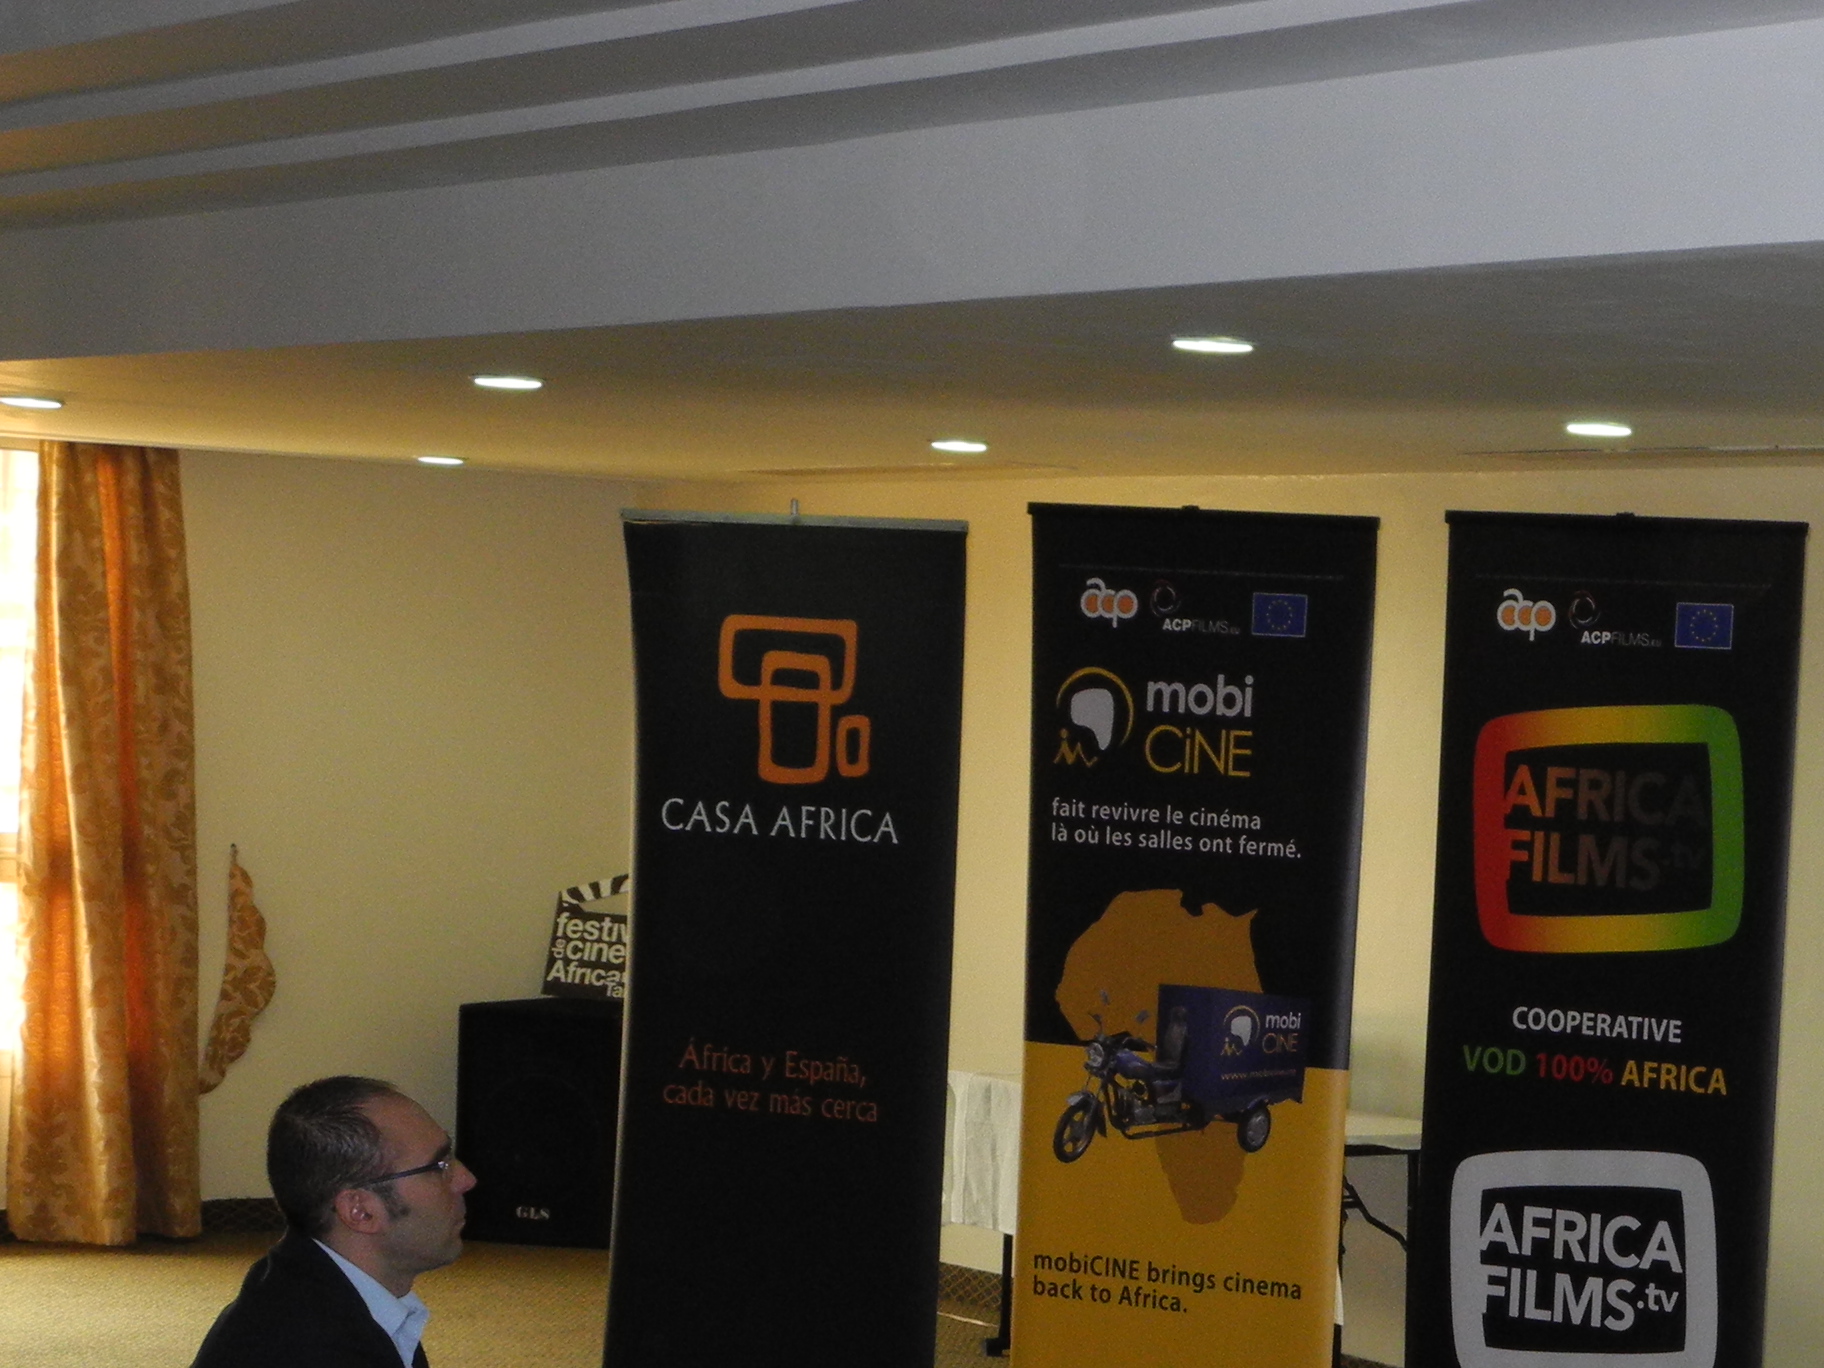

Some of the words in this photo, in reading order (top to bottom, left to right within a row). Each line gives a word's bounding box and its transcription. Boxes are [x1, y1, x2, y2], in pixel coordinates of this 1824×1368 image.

[1146, 674, 1254, 717] mobi
[1052, 797, 1085, 819] fait
[1092, 802, 1160, 823] revivre
[1167, 805, 1183, 825] le
[1190, 808, 1262, 830] cinéma
[1504, 764, 1707, 826] AFRICA
[662, 798, 758, 837] CASA
[771, 806, 899, 844] AFRICA
[1052, 822, 1067, 842] là
[1074, 825, 1099, 844] où
[1106, 826, 1132, 846] les
[1138, 829, 1193, 850] salles
[1199, 836, 1232, 853] ont
[1239, 836, 1302, 859] fermé.
[566, 940, 626, 964] cine
[1265, 1012, 1301, 1030] mobi
[1511, 1006, 1683, 1044] COOPERATIVE
[678, 1037, 750, 1074] África
[761, 1056, 775, 1080] y
[786, 1050, 867, 1088] España,
[1463, 1044, 1526, 1076] VOD
[1536, 1052, 1614, 1084] 100%
[1621, 1060, 1727, 1096] AFRICA
[663, 1080, 714, 1108] cada
[724, 1089, 760, 1111] vez
[769, 1089, 812, 1116] más
[821, 1098, 878, 1122] cerca
[1480, 1202, 1683, 1274] AFRICA
[1032, 1275, 1083, 1301] back
[1090, 1284, 1112, 1304] to
[1118, 1286, 1188, 1313] Africa.
[1033, 1252, 1140, 1280] mobiCINE
[1147, 1261, 1216, 1293] brings
[1223, 1272, 1302, 1300] cinema
[1480, 1263, 1679, 1332] FILMS.tv
